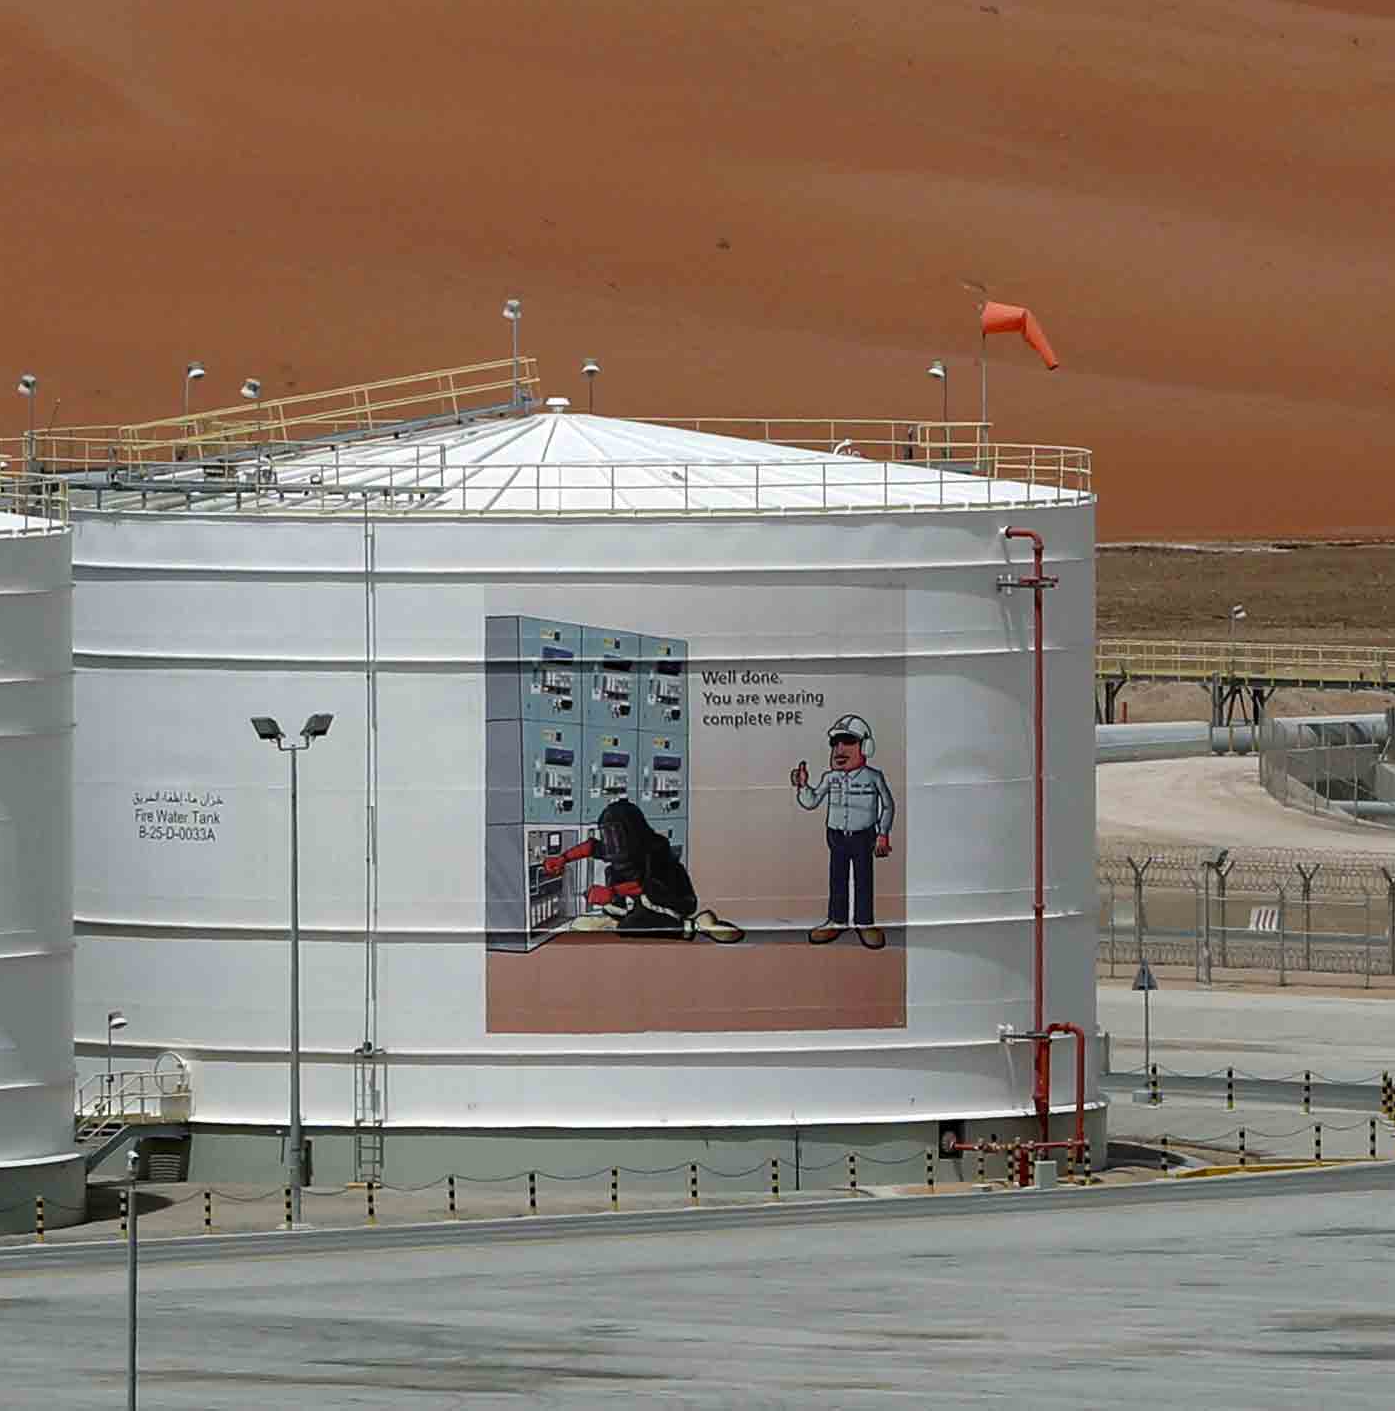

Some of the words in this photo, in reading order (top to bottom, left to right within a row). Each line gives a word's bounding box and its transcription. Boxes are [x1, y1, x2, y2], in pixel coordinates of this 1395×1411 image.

[701, 670, 736, 685] Well
[702, 691, 732, 705] You
[736, 693, 760, 705] are
[763, 689, 824, 708] wearing
[702, 711, 772, 728] complete
[775, 710, 804, 725] PPE
[135, 808, 154, 823] Fire
[155, 809, 188, 824] Water
[191, 810, 221, 825] Tank
